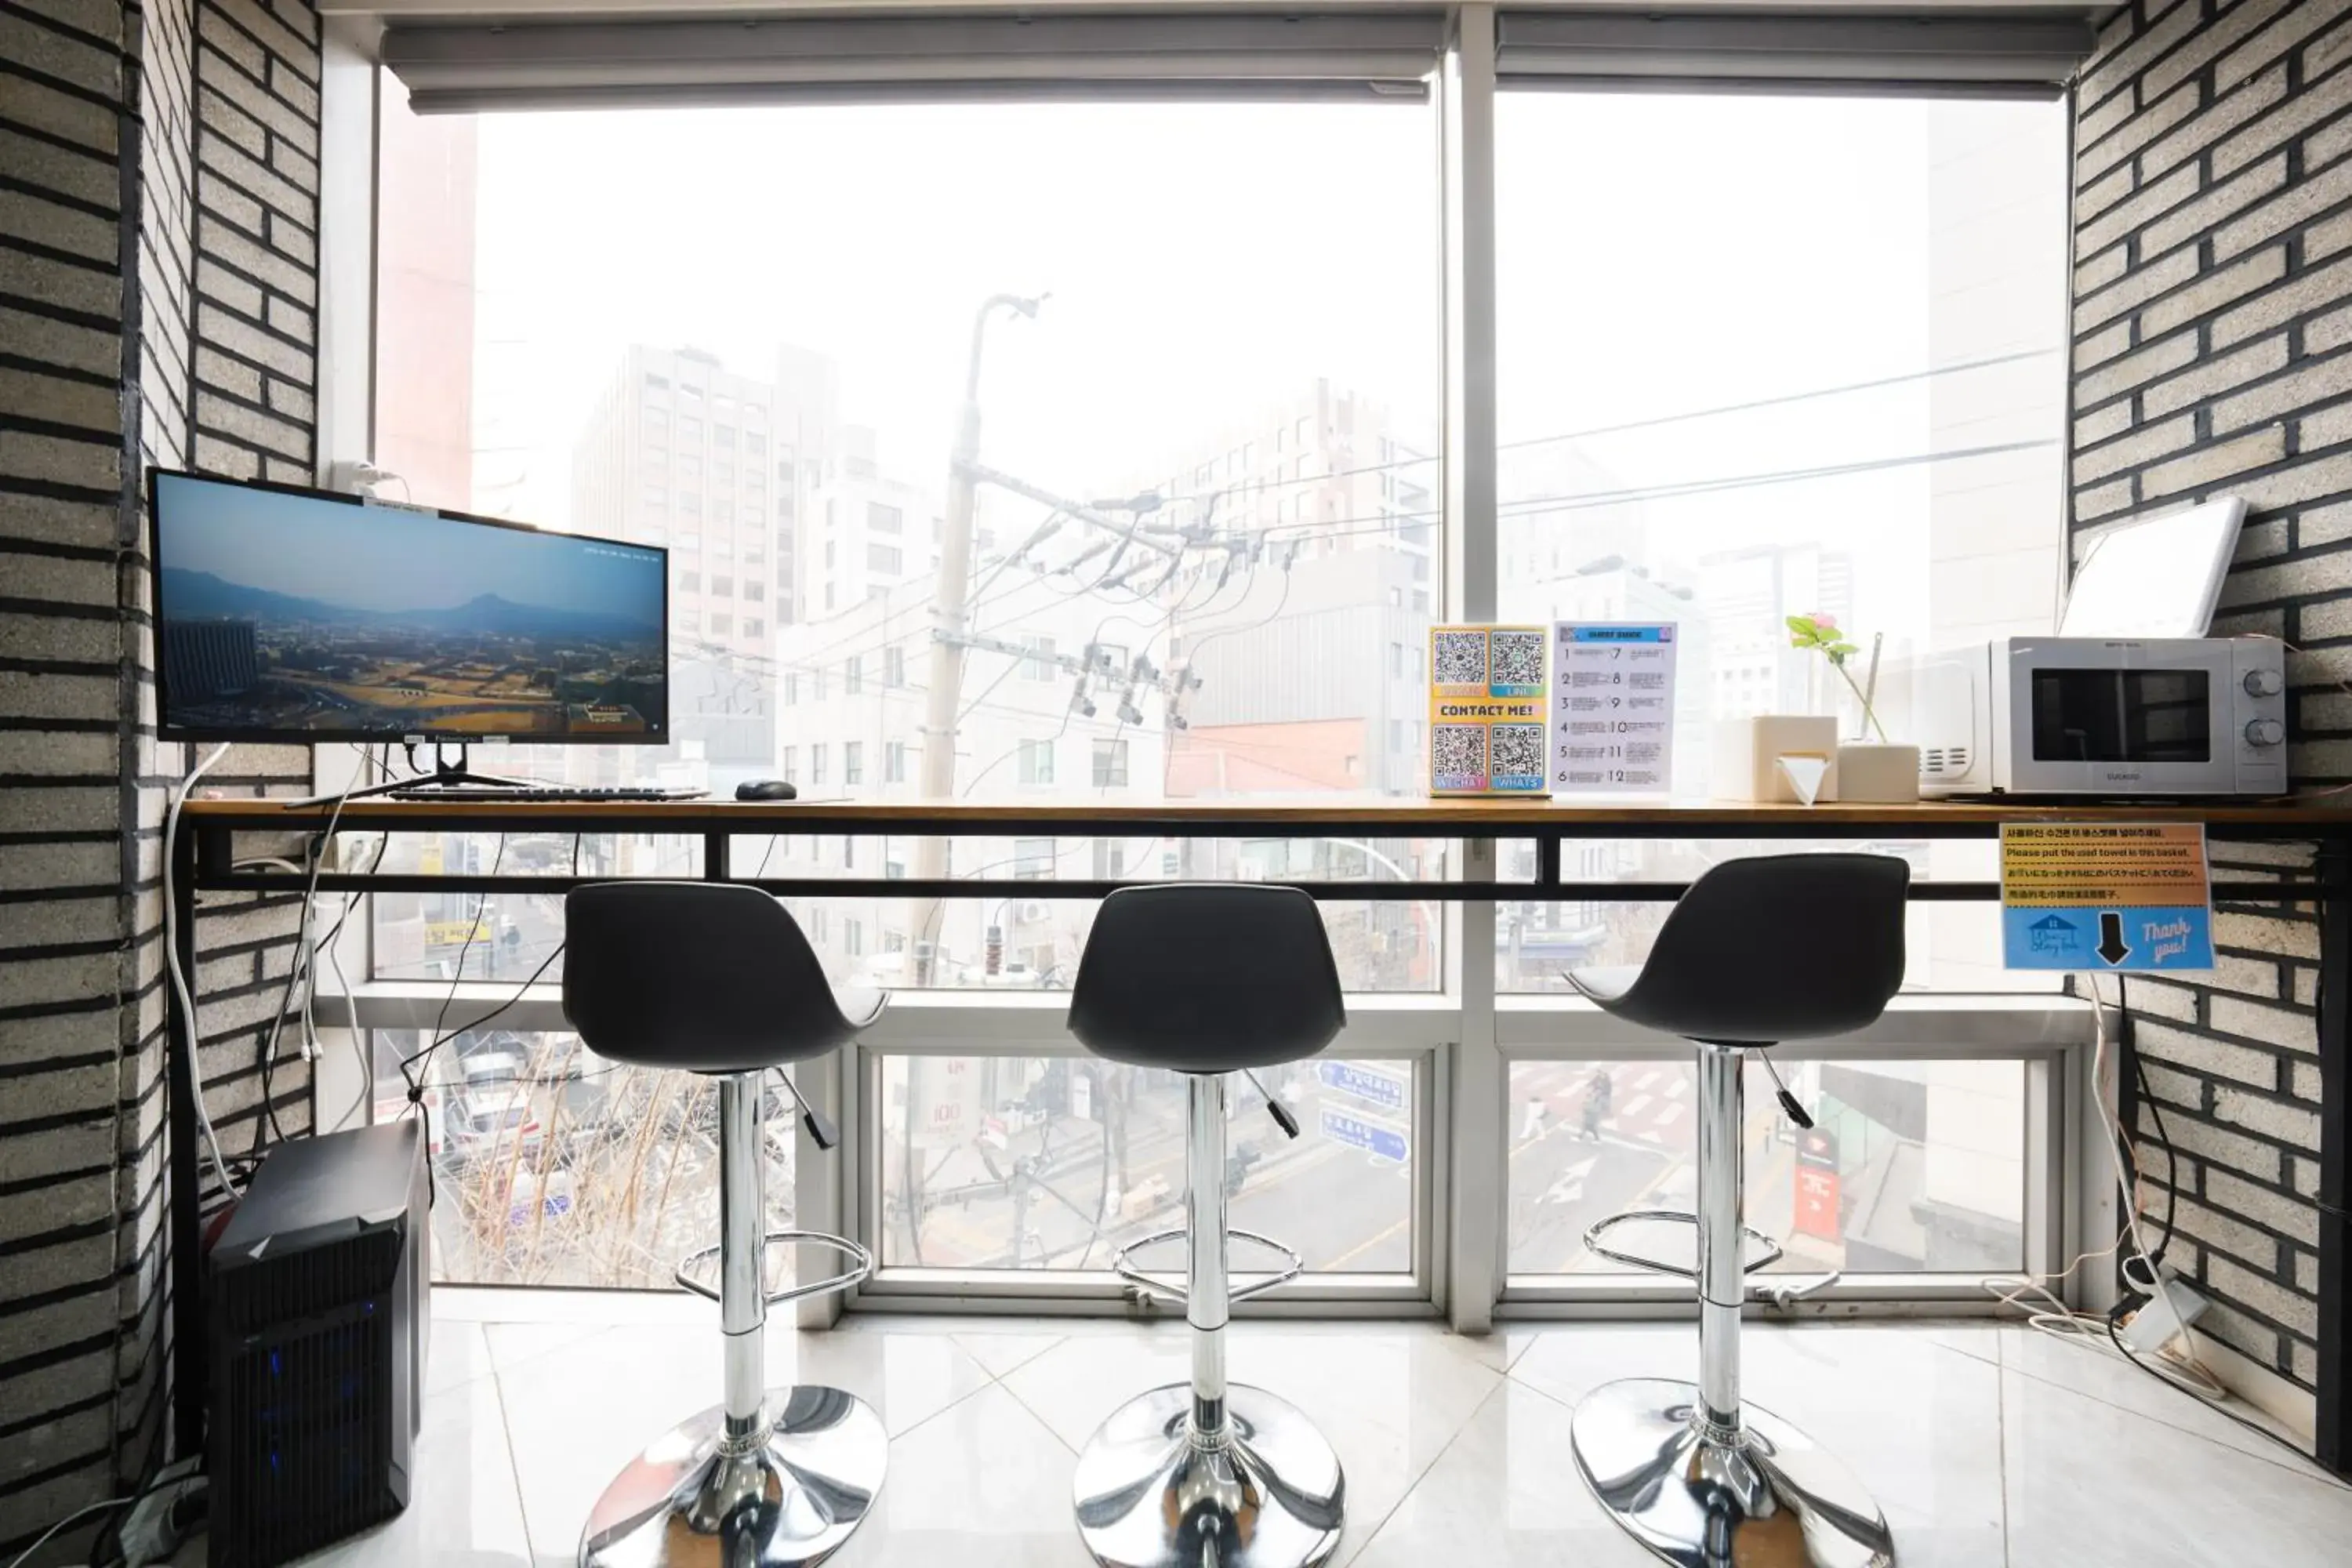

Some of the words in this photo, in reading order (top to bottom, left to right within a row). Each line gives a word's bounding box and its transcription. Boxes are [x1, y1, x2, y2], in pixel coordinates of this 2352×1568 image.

[1612, 648, 1621, 659] 7
[1561, 673, 1570, 684] 2
[1613, 672, 1621, 684] 8
[1561, 697, 1569, 710] 3
[1611, 697, 1621, 709] 9
[1440, 704, 1504, 717] CONTACT
[1508, 704, 1534, 717] ME!
[1560, 721, 1568, 733] 4
[1610, 721, 1628, 733] 10
[1559, 746, 1567, 758] 5
[1609, 746, 1621, 757] 11
[1558, 771, 1567, 782] 6
[1609, 770, 1624, 782] 12
[2006, 848, 2041, 857] Please
[2042, 848, 2059, 858] put
[2060, 848, 2075, 857] the
[2100, 848, 2127, 857] towel
[2139, 848, 2154, 857] this
[2141, 916, 2192, 942] Thank
[2154, 934, 2187, 964] you!
